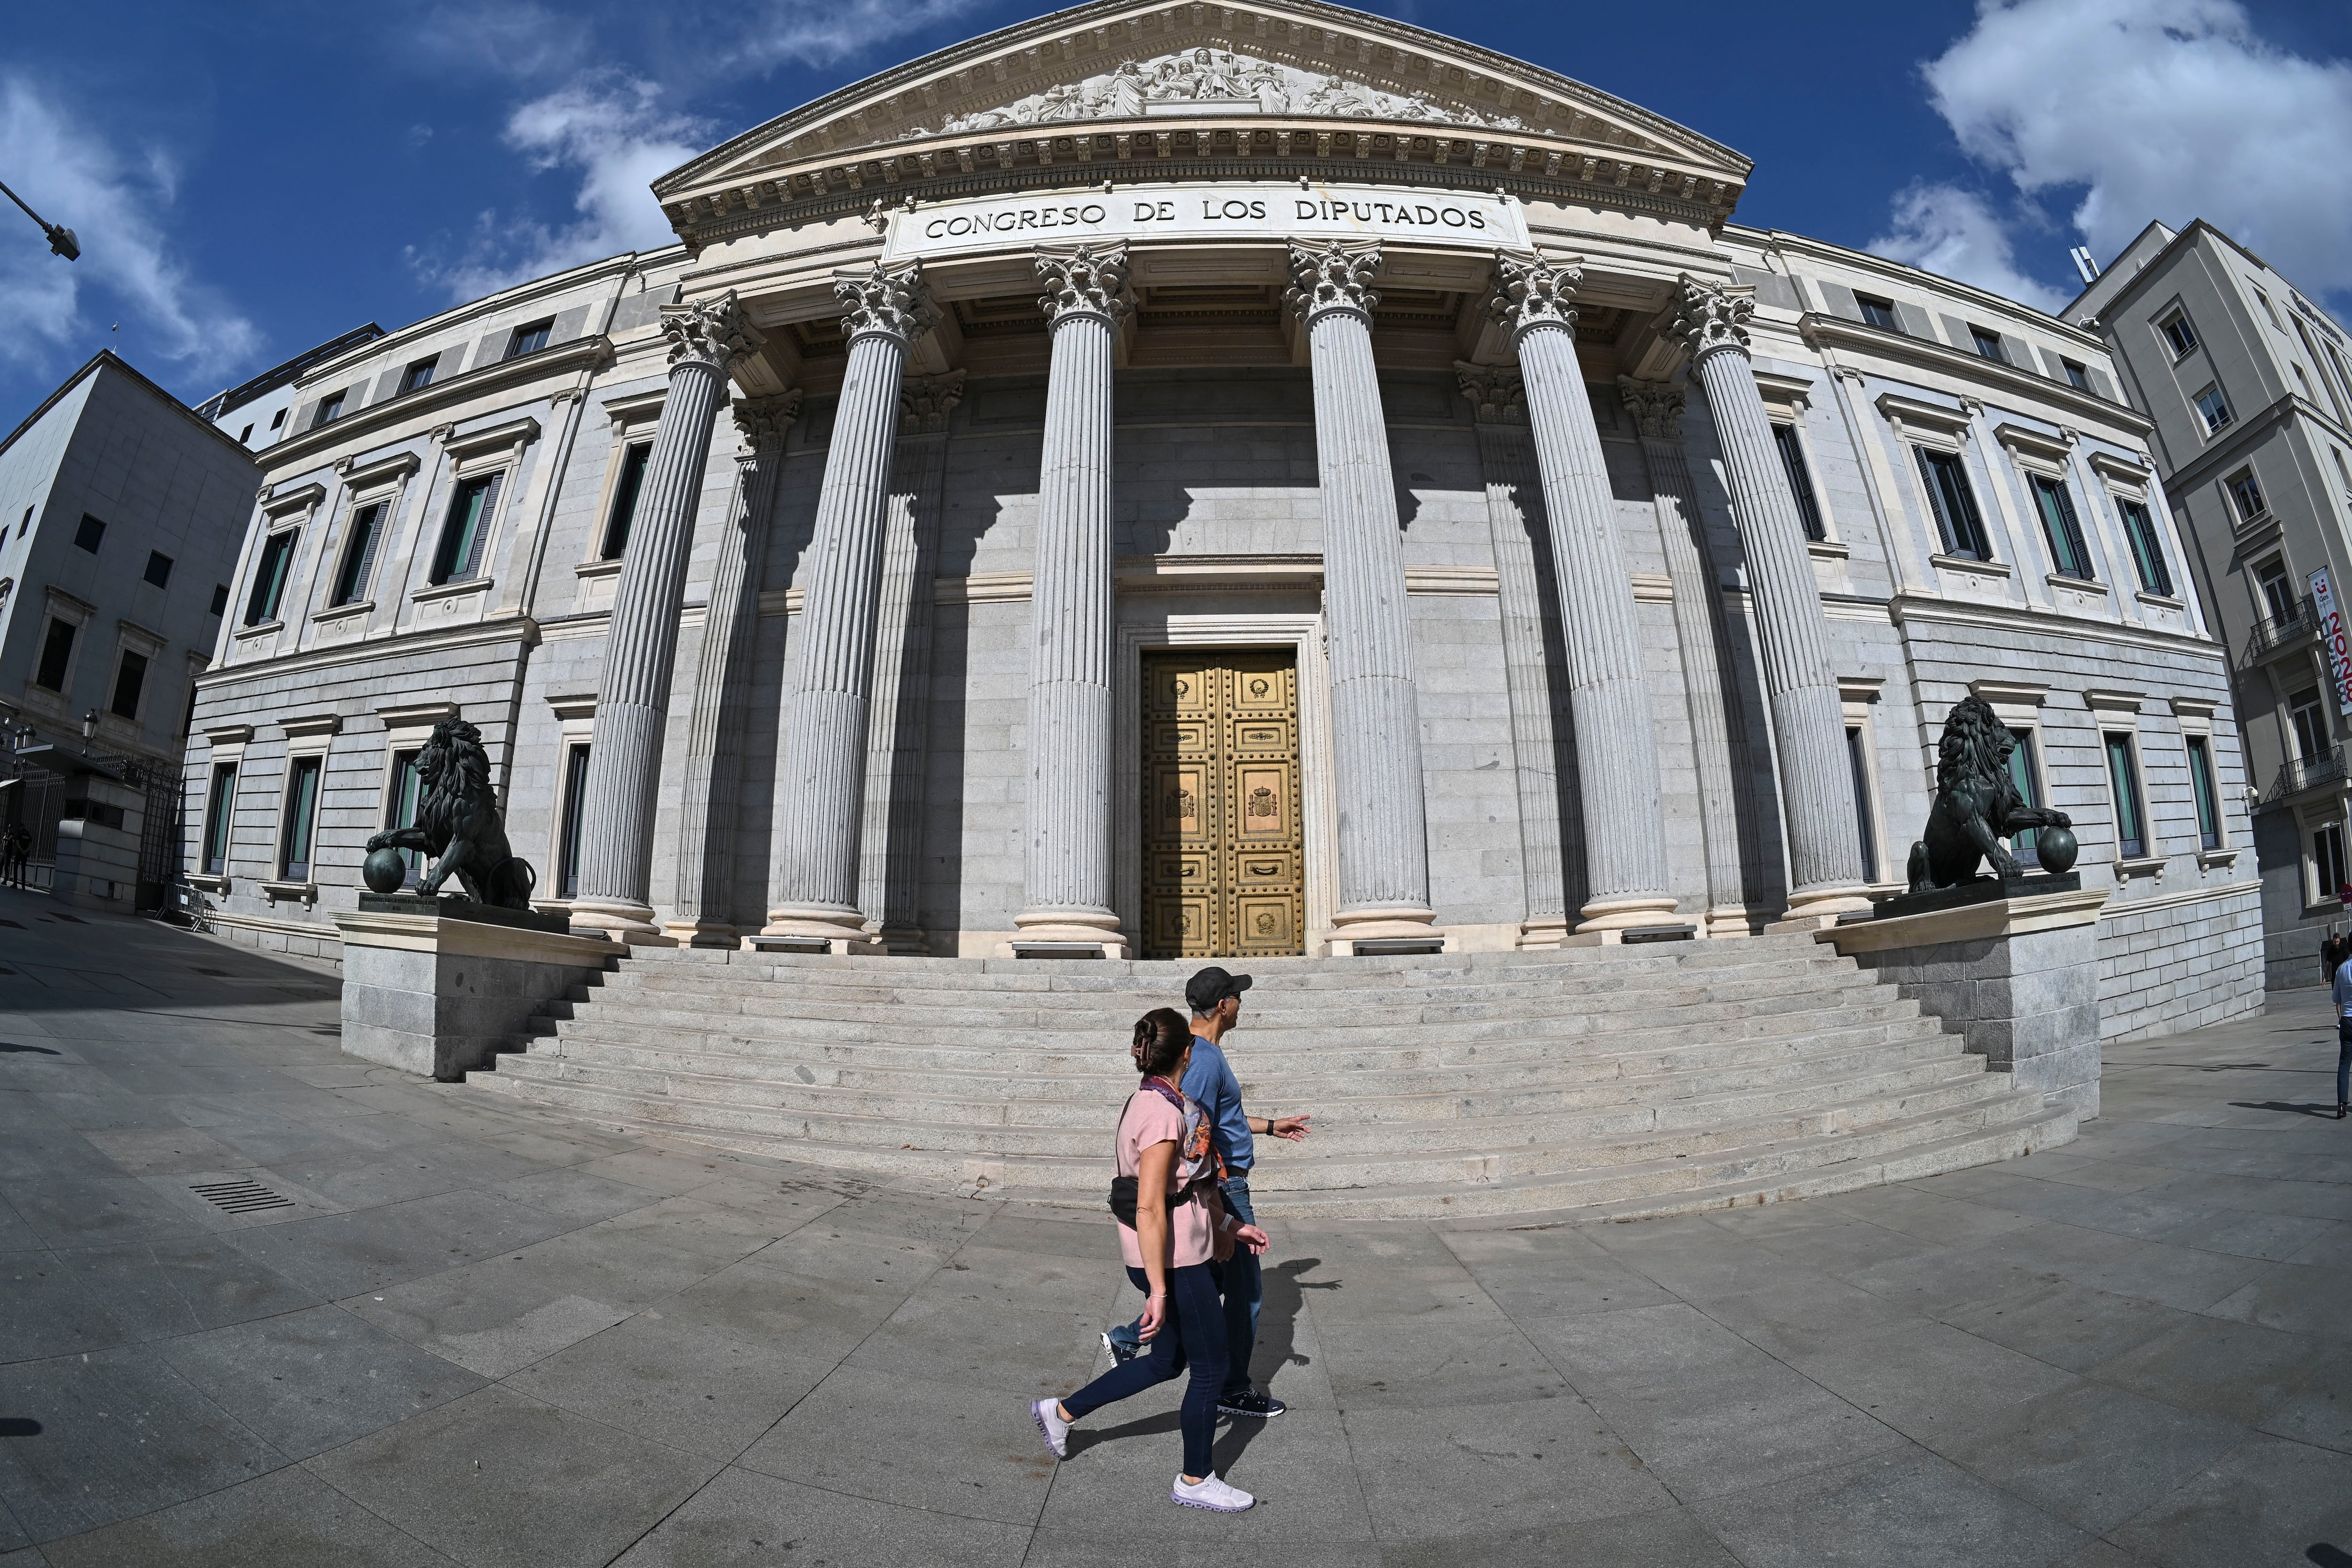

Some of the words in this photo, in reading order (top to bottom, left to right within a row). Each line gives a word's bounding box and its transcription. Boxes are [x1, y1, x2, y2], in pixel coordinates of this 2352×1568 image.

[925, 204, 1105, 238] CONGRESO
[1133, 201, 1175, 222] DE
[1203, 200, 1266, 219] LOS
[1295, 200, 1485, 229] DIPUTADOS
[2318, 599, 2333, 609] seguros
